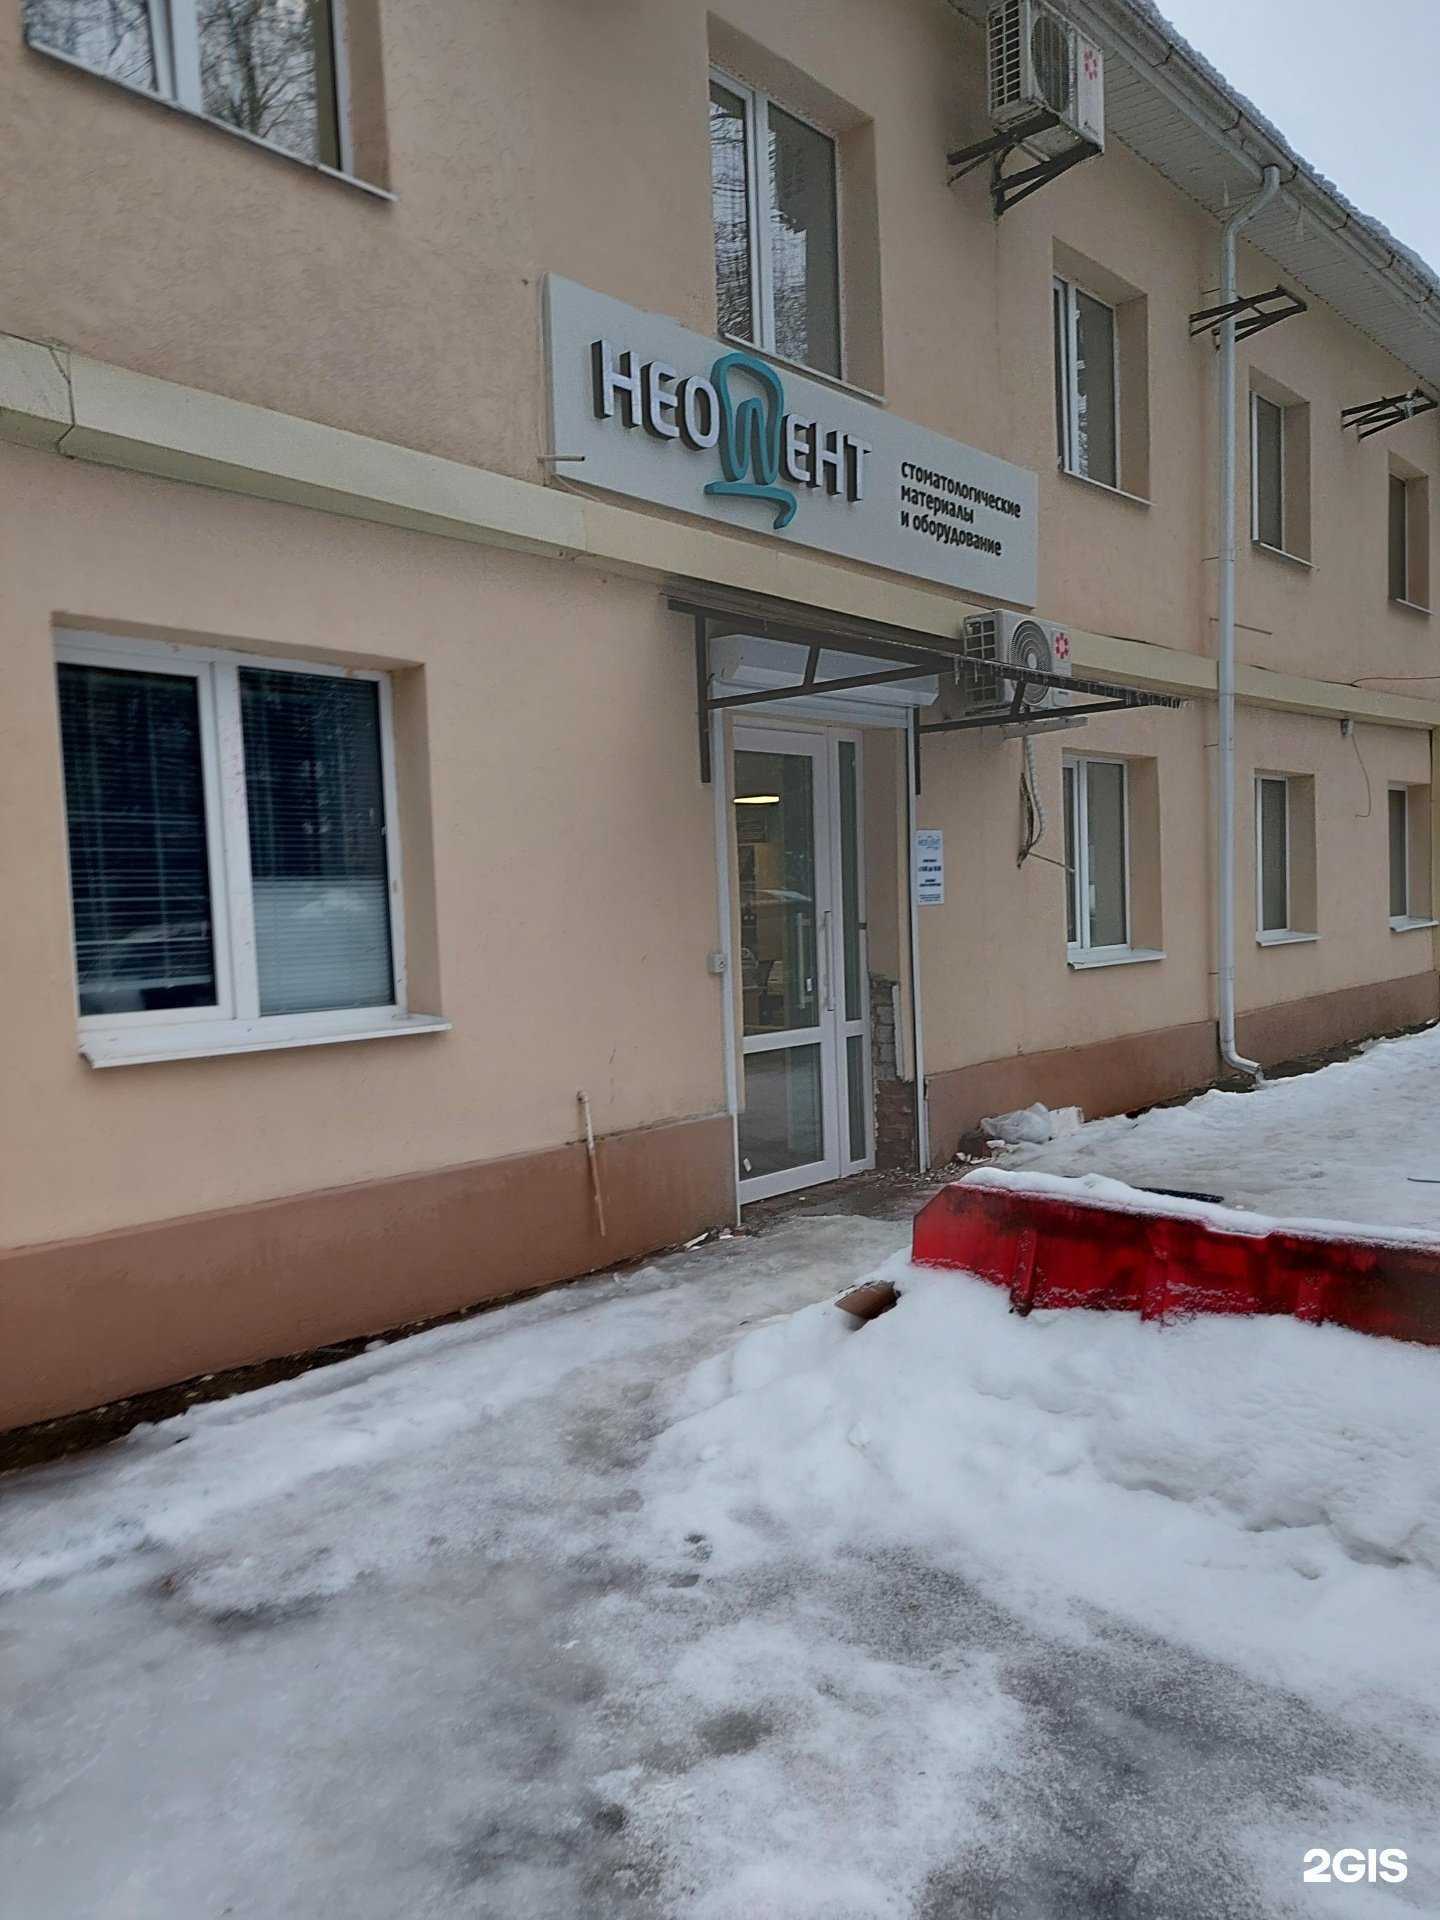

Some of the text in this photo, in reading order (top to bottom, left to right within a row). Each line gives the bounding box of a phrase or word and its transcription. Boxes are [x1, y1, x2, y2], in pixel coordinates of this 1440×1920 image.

[591, 340, 872, 529] НЕОДЕНТ
[902, 462, 1021, 518] стоматологические
[902, 486, 974, 523] материалы
[901, 510, 1001, 556] и оборудование
